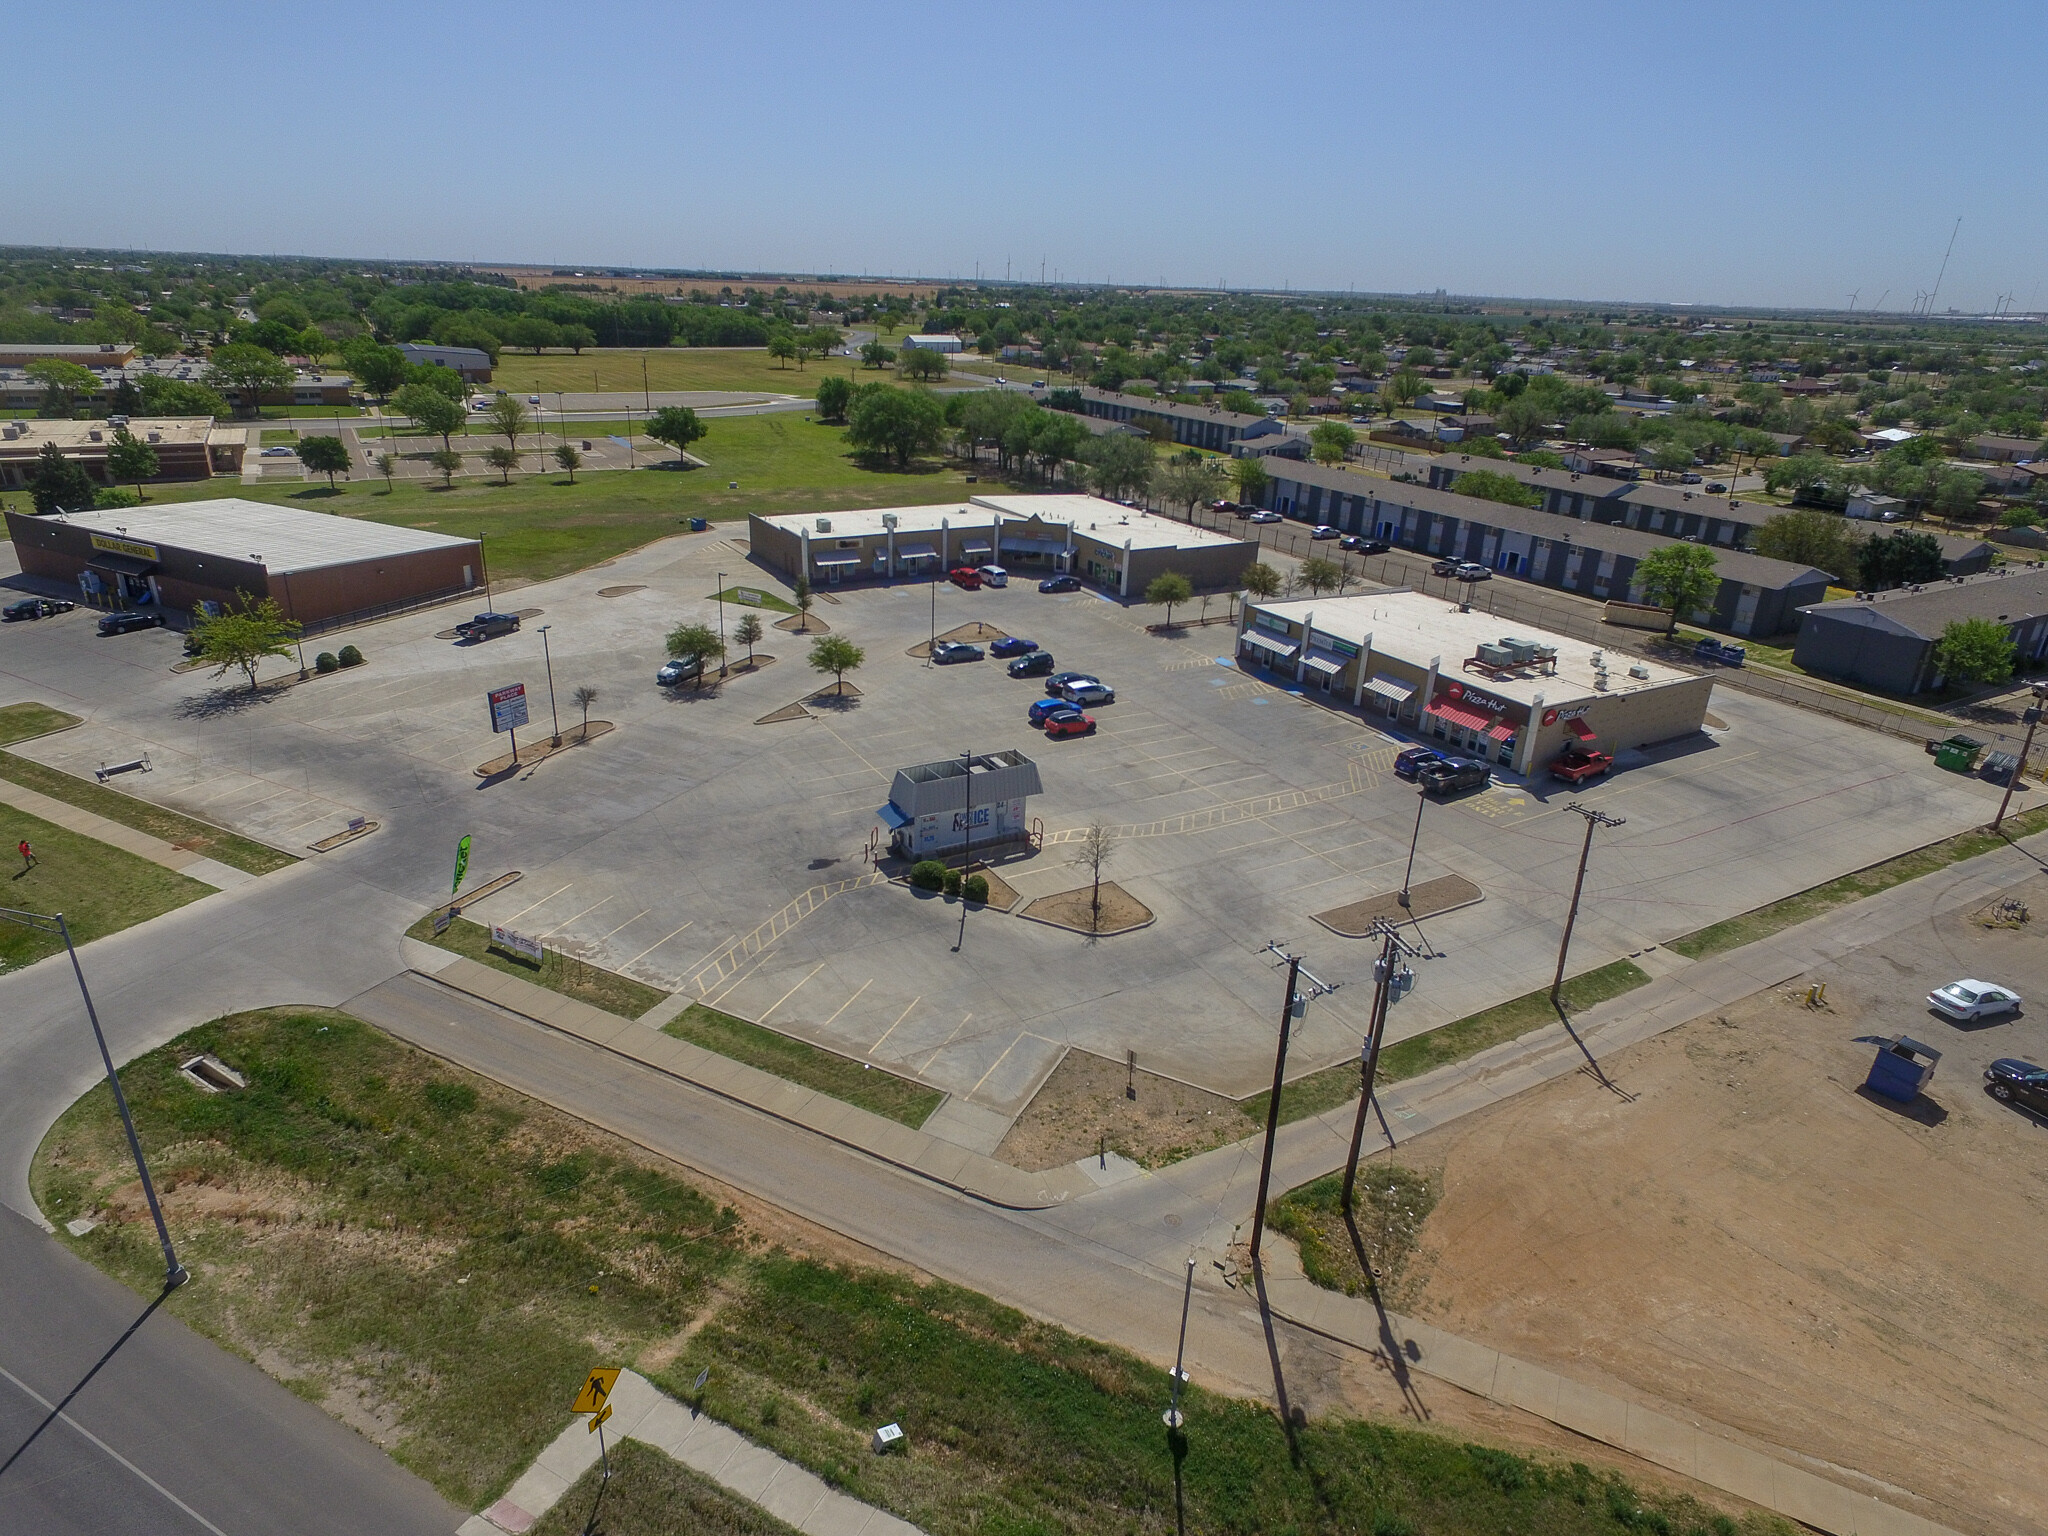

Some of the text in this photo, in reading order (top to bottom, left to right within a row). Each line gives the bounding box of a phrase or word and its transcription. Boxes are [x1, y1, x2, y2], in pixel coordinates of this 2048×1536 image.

[95, 538, 153, 558] DOLLAR GENERAL
[494, 686, 522, 698] PARKWAY
[500, 692, 519, 701] PLACE
[1462, 690, 1507, 712] Pizza Hut
[1556, 705, 1591, 721] Pizza Hut
[973, 808, 990, 825] ICE
